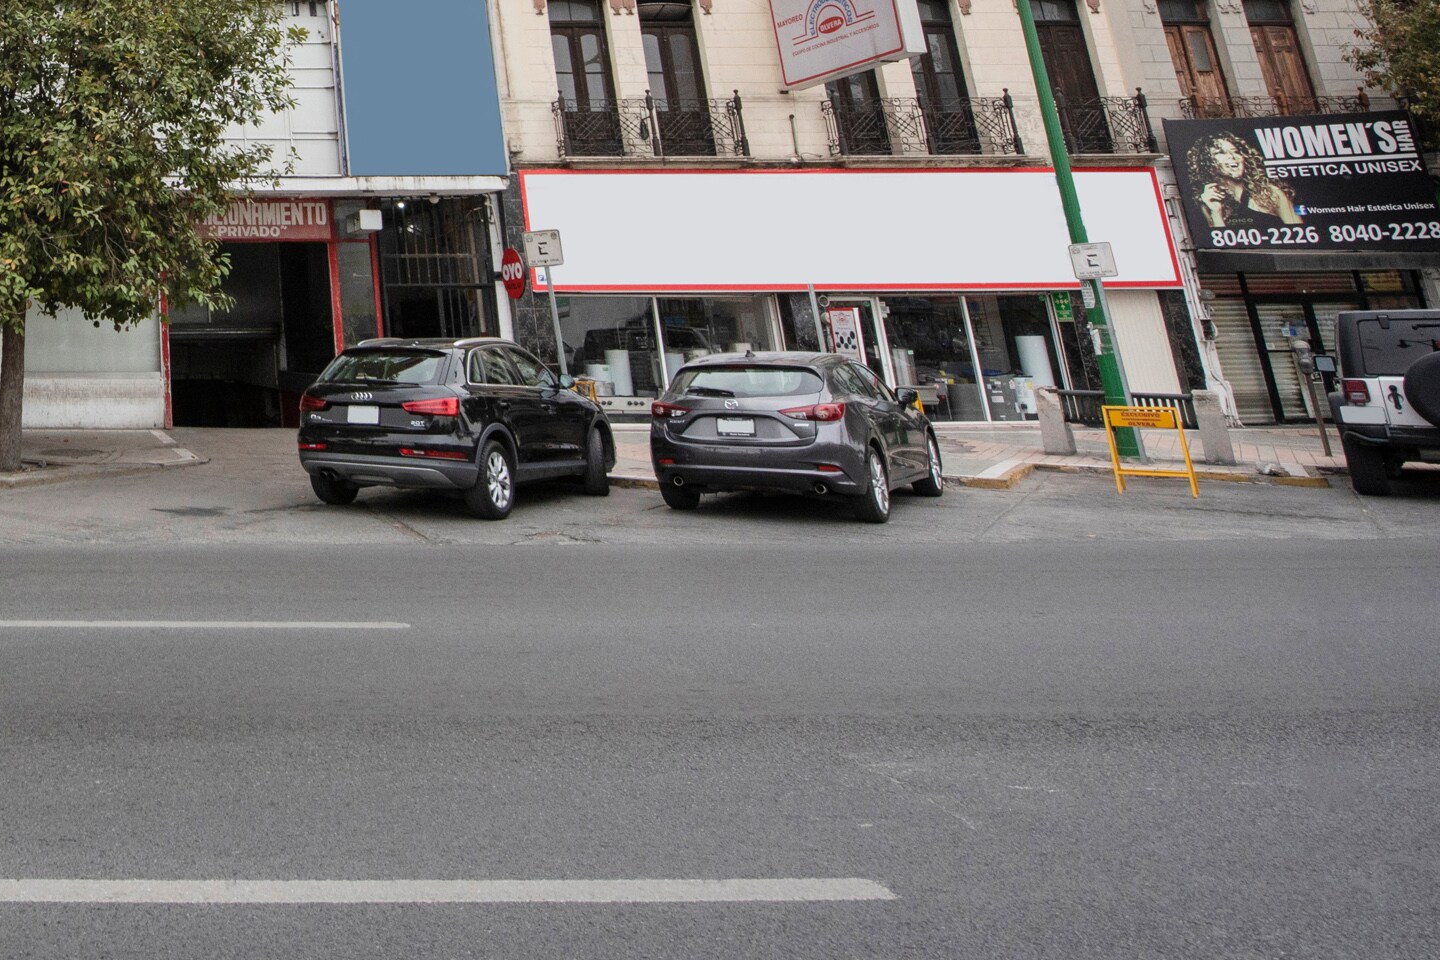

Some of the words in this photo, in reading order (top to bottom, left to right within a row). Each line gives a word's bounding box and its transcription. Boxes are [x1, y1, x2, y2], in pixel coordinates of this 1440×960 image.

[777, 14, 803, 28] MAYOREO
[820, 19, 843, 31] OLVERA
[1392, 120, 1416, 152] HAIR
[1265, 163, 1352, 179] ESTETICA
[1354, 159, 1423, 174] UNISEX
[1307, 205, 1346, 214] Womens
[1346, 204, 1365, 213] Hair
[1367, 203, 1403, 212] Estetica
[1403, 202, 1435, 210] Unisex
[1211, 226, 1320, 247] 8040-2226
[1328, 221, 1440, 242] 8040-2228
[503, 262, 523, 281] OYO
